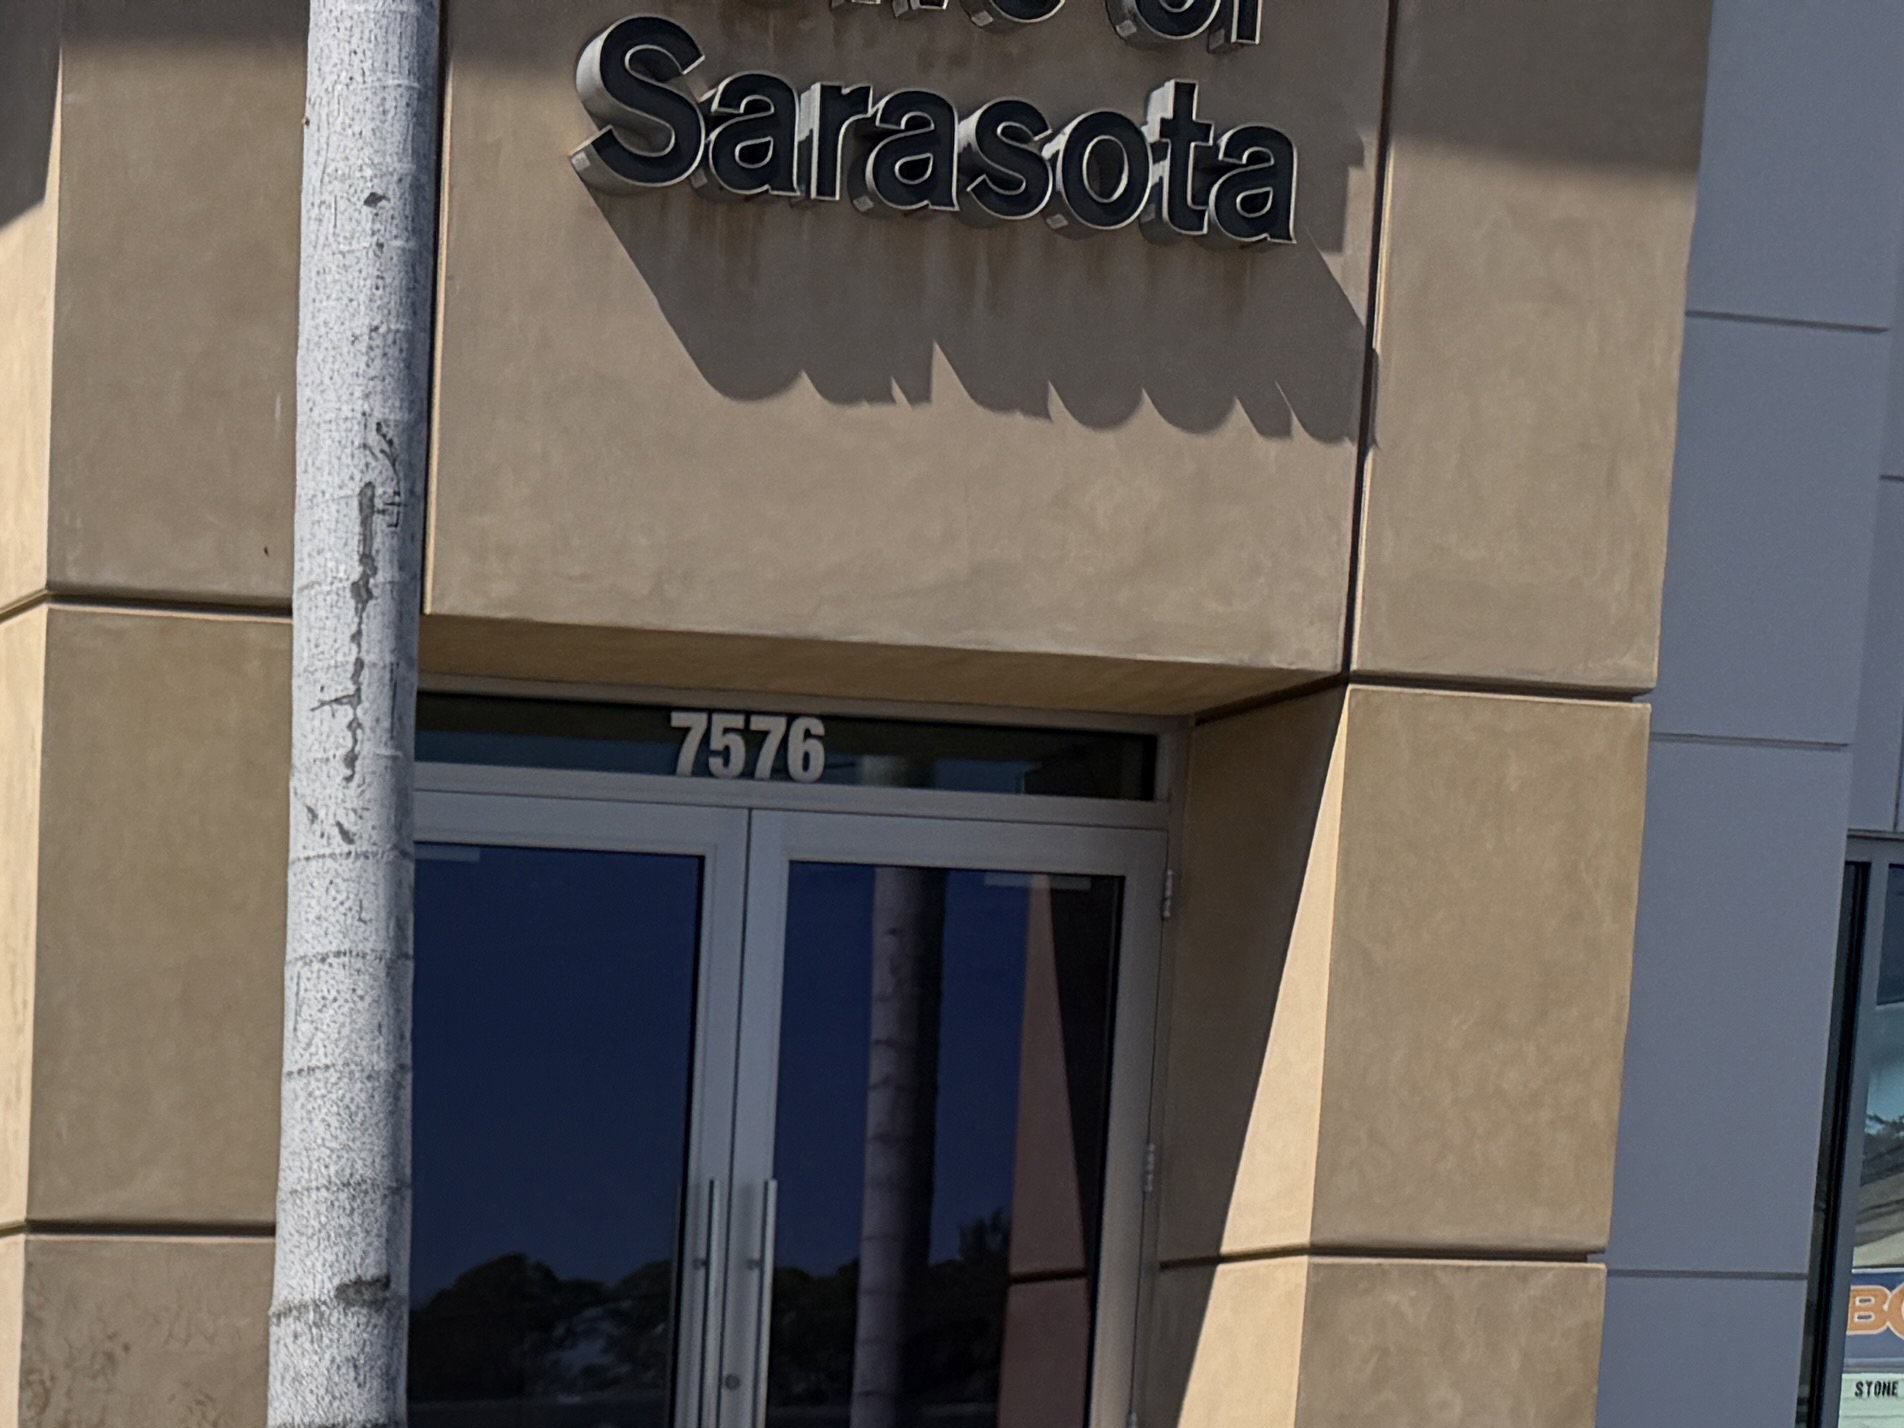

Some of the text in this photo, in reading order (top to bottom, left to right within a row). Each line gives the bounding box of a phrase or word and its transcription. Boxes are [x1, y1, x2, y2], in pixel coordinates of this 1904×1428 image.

[574, 14, 1299, 245] Sarasota
[669, 710, 826, 783] 7576
[1854, 1380, 1899, 1398] STONE
